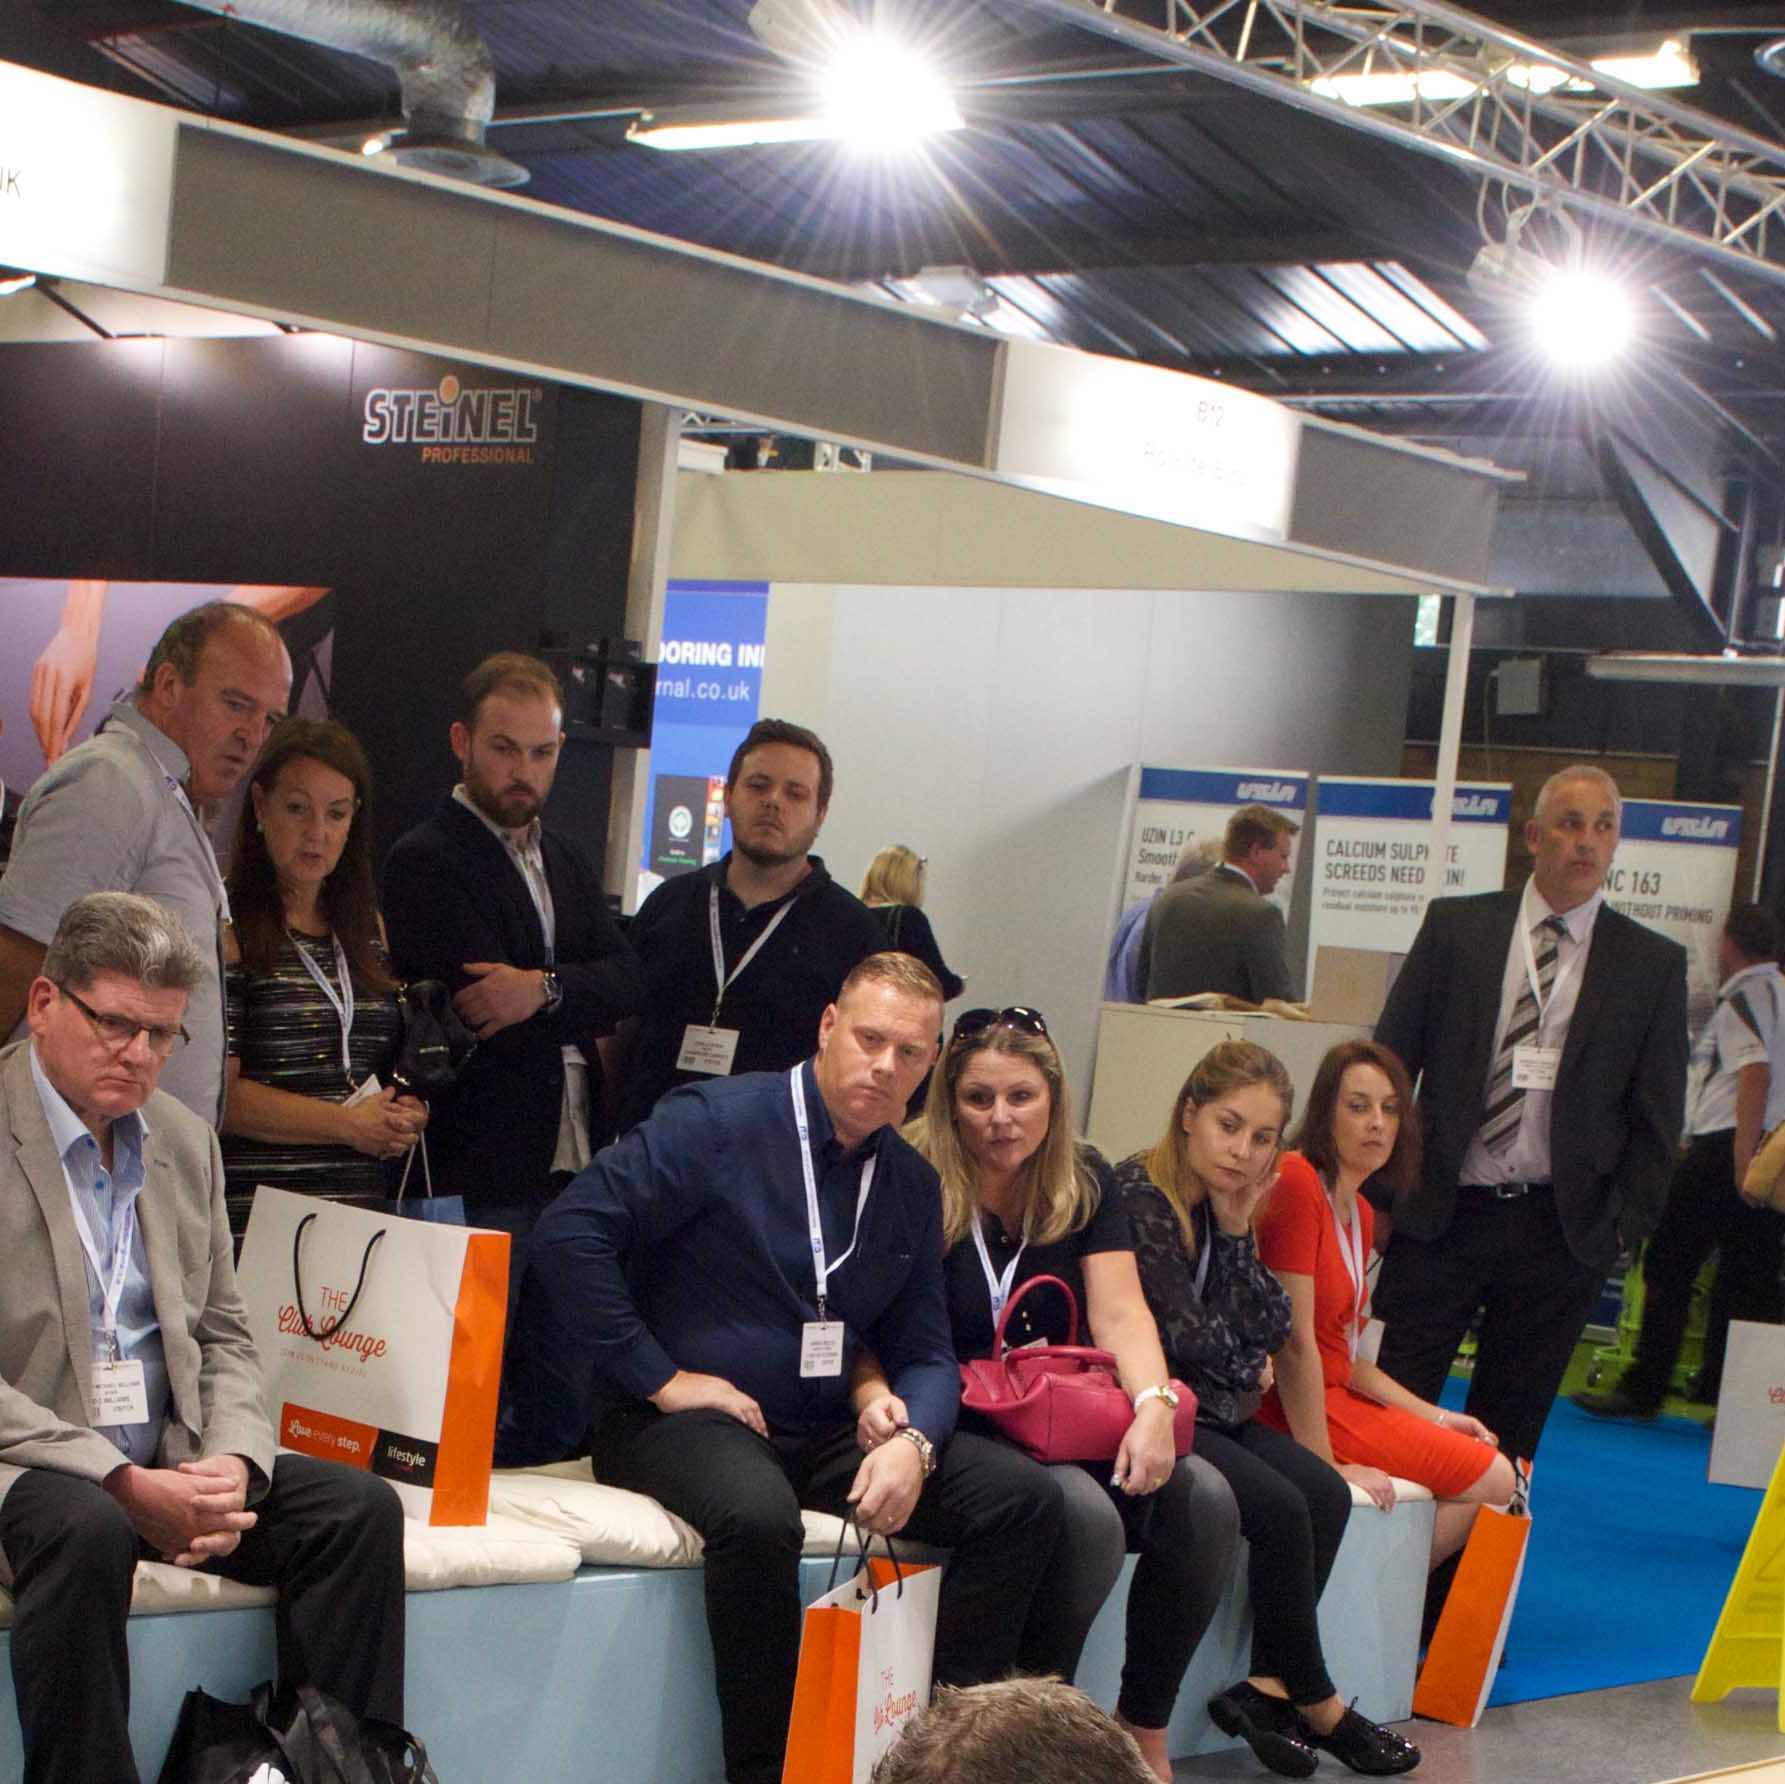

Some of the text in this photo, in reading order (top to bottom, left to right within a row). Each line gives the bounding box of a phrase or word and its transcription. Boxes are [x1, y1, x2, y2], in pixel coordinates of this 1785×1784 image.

[420, 447, 536, 465] PROFESSIONAL
[737, 643, 765, 668] IN
[655, 676, 751, 702] rnal.co.uk
[1142, 827, 1167, 844] UZIN
[1326, 839, 1460, 864] CALCIUM SULPTE
[1324, 862, 1386, 883] SCREEDS
[1389, 865, 1426, 885] NEED
[1632, 870, 1661, 896] 163
[1666, 905, 1714, 925] PRIMING
[321, 1285, 348, 1313] THE
[319, 1314, 387, 1363] Lounge
[337, 1435, 361, 1455] step.
[387, 1445, 426, 1468] lifestyle
